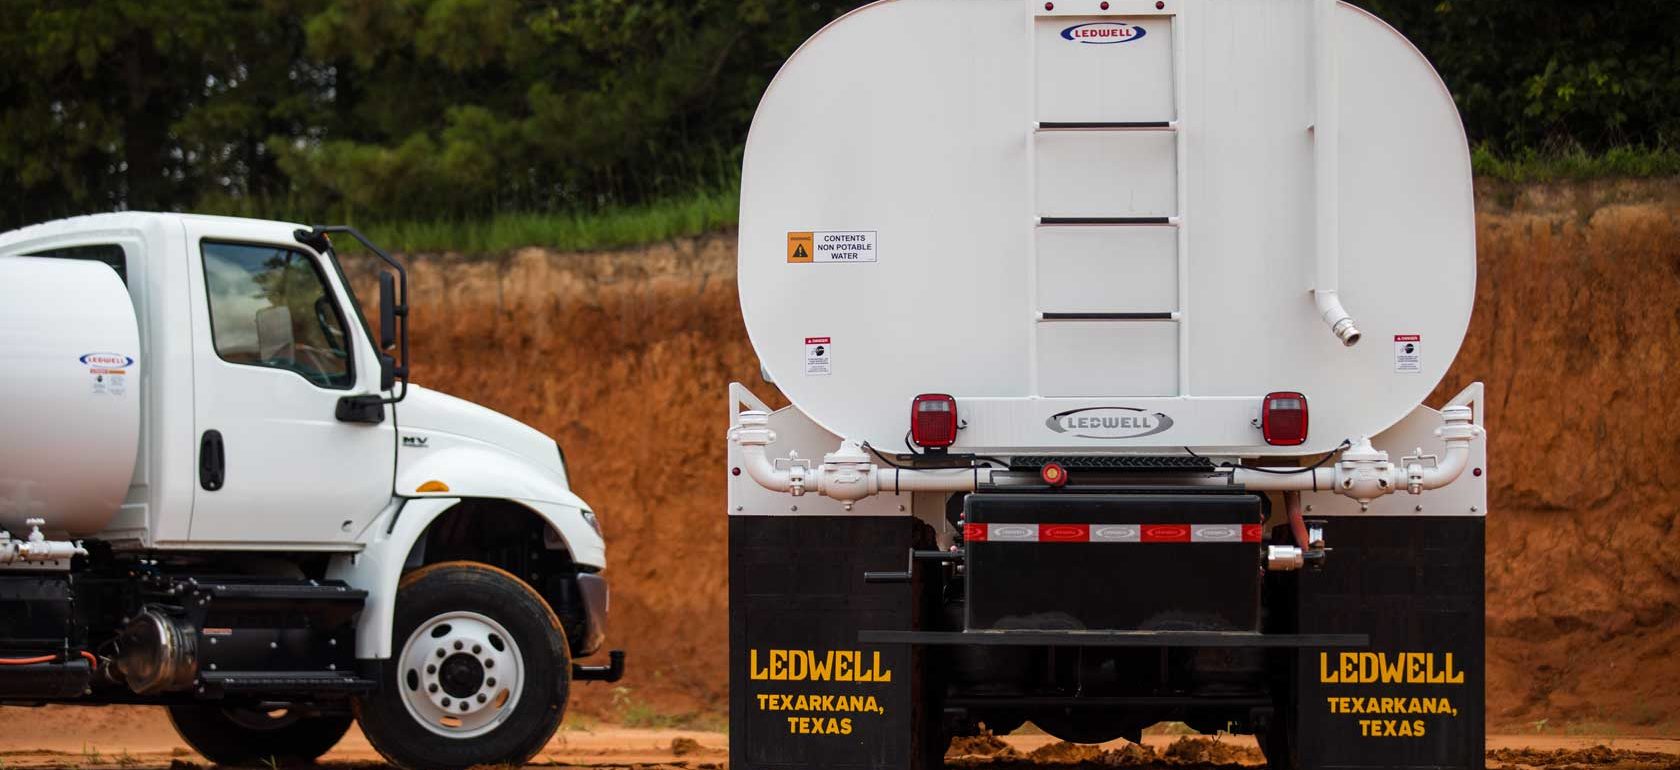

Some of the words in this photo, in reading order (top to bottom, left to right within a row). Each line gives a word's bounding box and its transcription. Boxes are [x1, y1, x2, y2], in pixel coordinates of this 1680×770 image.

[1074, 29, 1132, 38] LEDWELL
[1067, 417, 1151, 429] LEDWELL
[403, 436, 428, 444] MV
[750, 649, 892, 682] LEDWELL
[1320, 652, 1465, 684] LEDWELL
[757, 694, 884, 715] TEXARKANA,
[1327, 697, 1457, 717] TEXARKANA,
[788, 717, 853, 735] TEXAS
[1359, 720, 1426, 737] TEXAS
